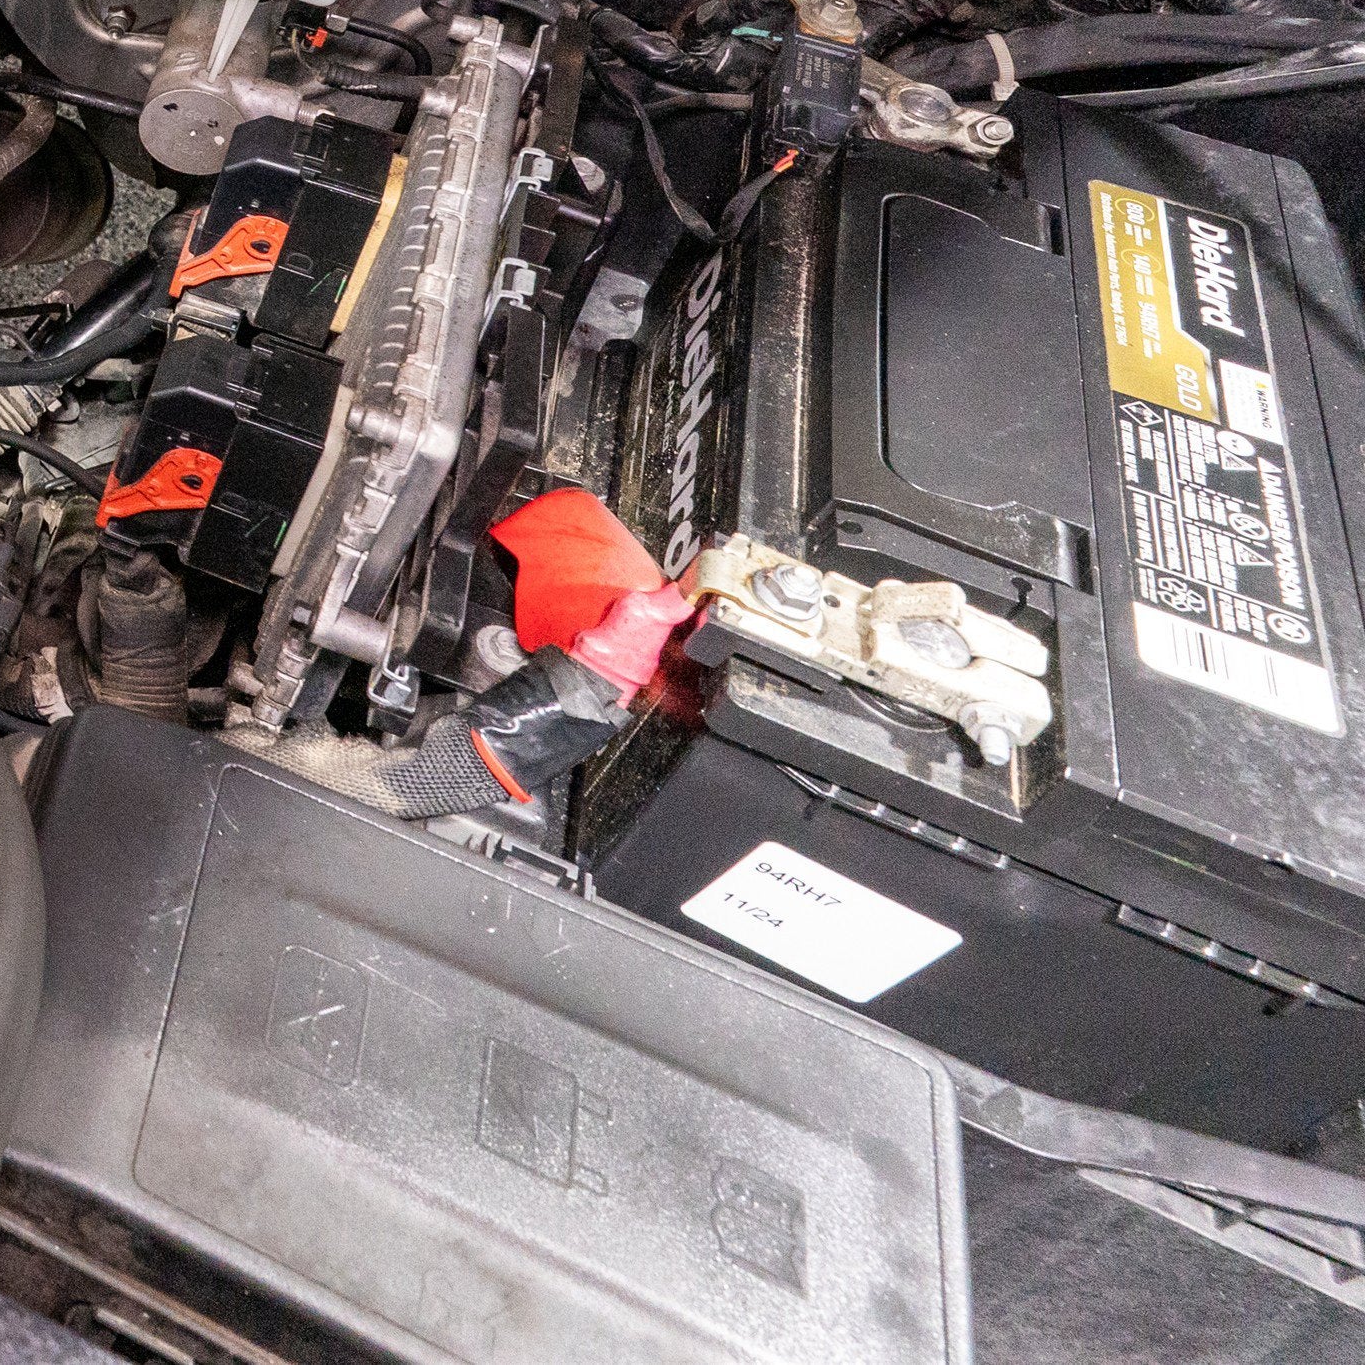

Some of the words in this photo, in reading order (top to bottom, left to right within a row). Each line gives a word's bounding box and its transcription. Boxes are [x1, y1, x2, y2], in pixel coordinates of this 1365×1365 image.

[1125, 201, 1145, 225] 800
[1131, 252, 1151, 275] 140
[1185, 216, 1247, 338] DieHard
[1173, 362, 1203, 412] GOLD
[1255, 388, 1272, 429] WARNING
[664, 250, 722, 580] DieHard
[1259, 471, 1305, 610] DANGER/POISON
[754, 861, 843, 908] 94RH7
[721, 891, 785, 928] 11/24
